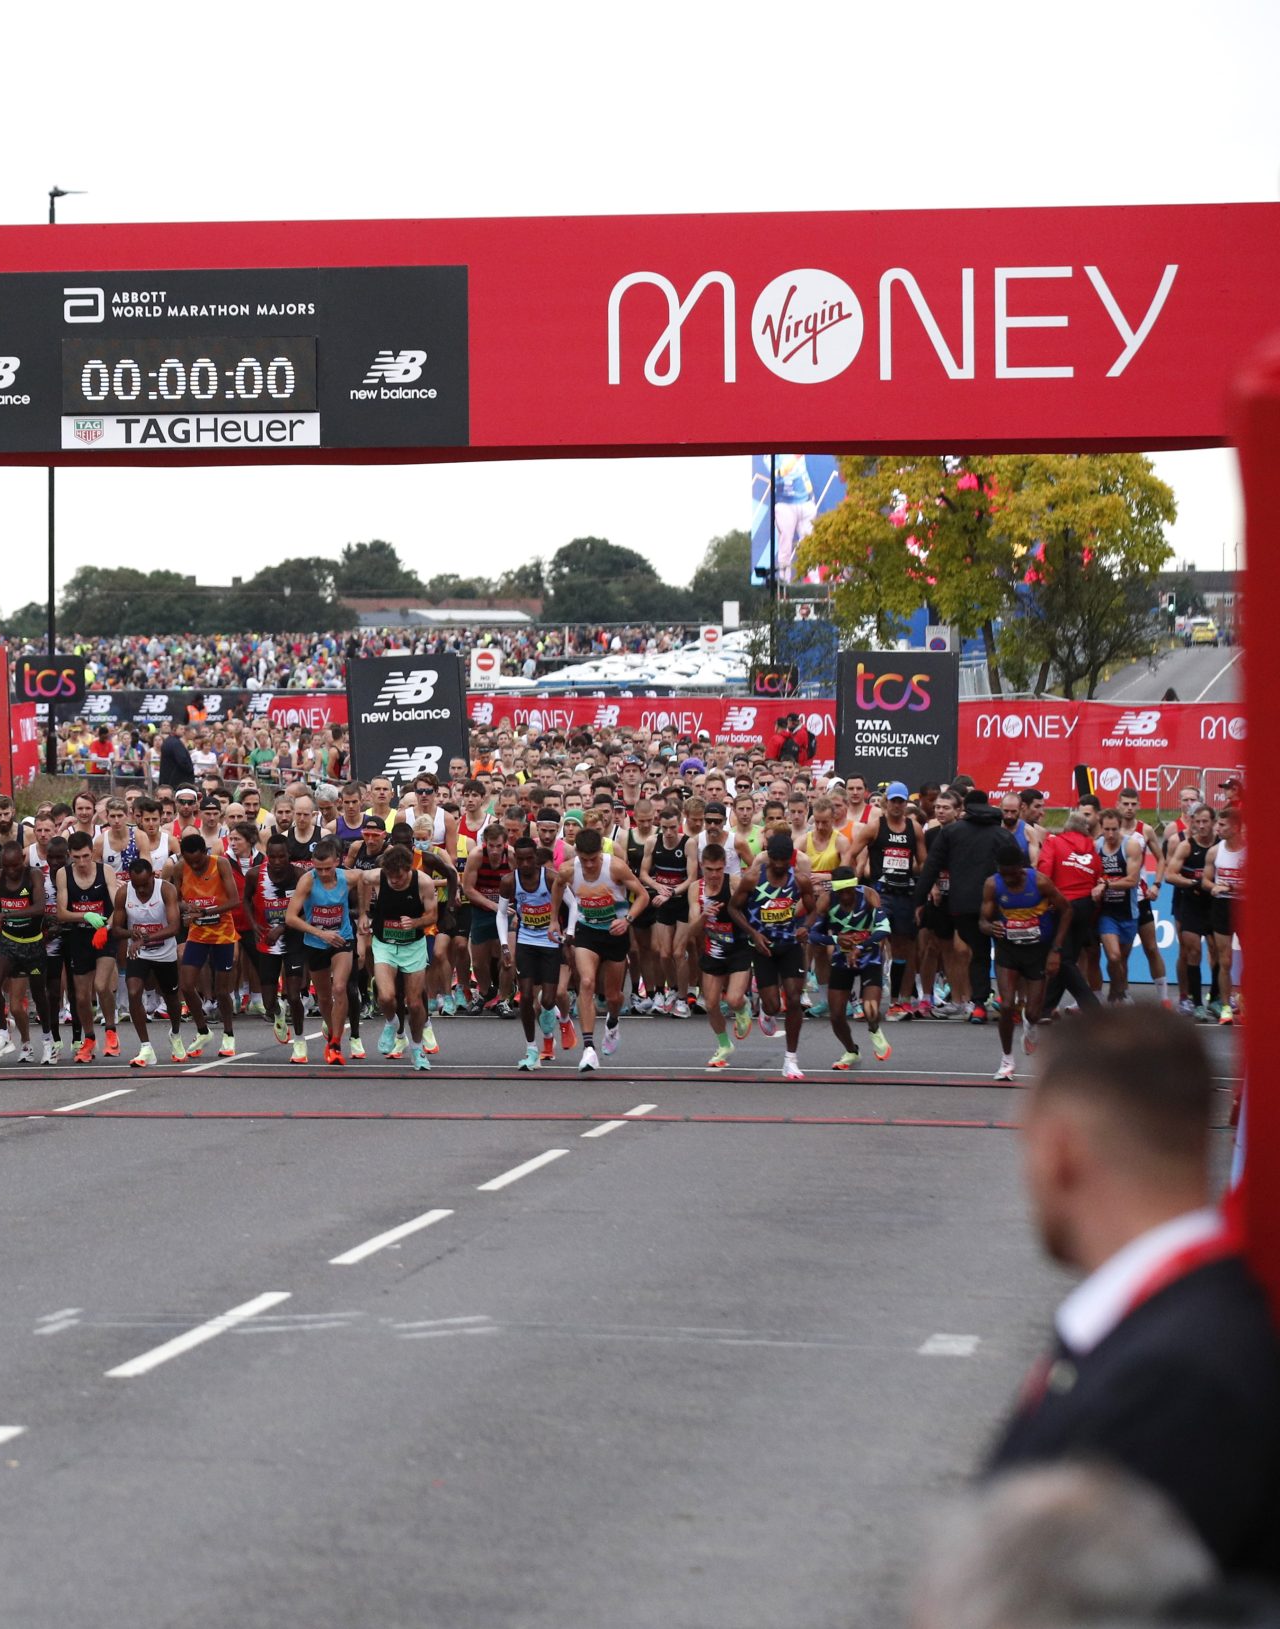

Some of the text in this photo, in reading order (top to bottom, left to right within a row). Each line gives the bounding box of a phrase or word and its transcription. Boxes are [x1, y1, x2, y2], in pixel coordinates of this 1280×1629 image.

[112, 291, 167, 303] ABBOTT
[111, 302, 316, 317] WORLD MARATHON MAJORS
[608, 264, 1179, 387] MONEY
[761, 285, 852, 365] Virgin
[81, 356, 295, 400] 00:00:00
[350, 386, 437, 400] new balance
[76, 419, 102, 429] TAG
[76, 429, 102, 441] HEUER
[24, 663, 77, 697] tcs
[856, 662, 931, 712] tcs
[361, 708, 451, 723] new balance
[855, 719, 892, 731] TATA
[977, 713, 1080, 740] MONEY
[731, 733, 763, 743] balance
[855, 732, 940, 745] CONSULTANCY
[1102, 738, 1168, 748] new balance
[854, 745, 909, 758] SERVICES
[888, 833, 907, 843] JAMES
[1, 900, 28, 908] MONEY
[524, 904, 550, 914] MONEY
[312, 907, 343, 915] MONEY
[761, 909, 791, 921] LEMMA
